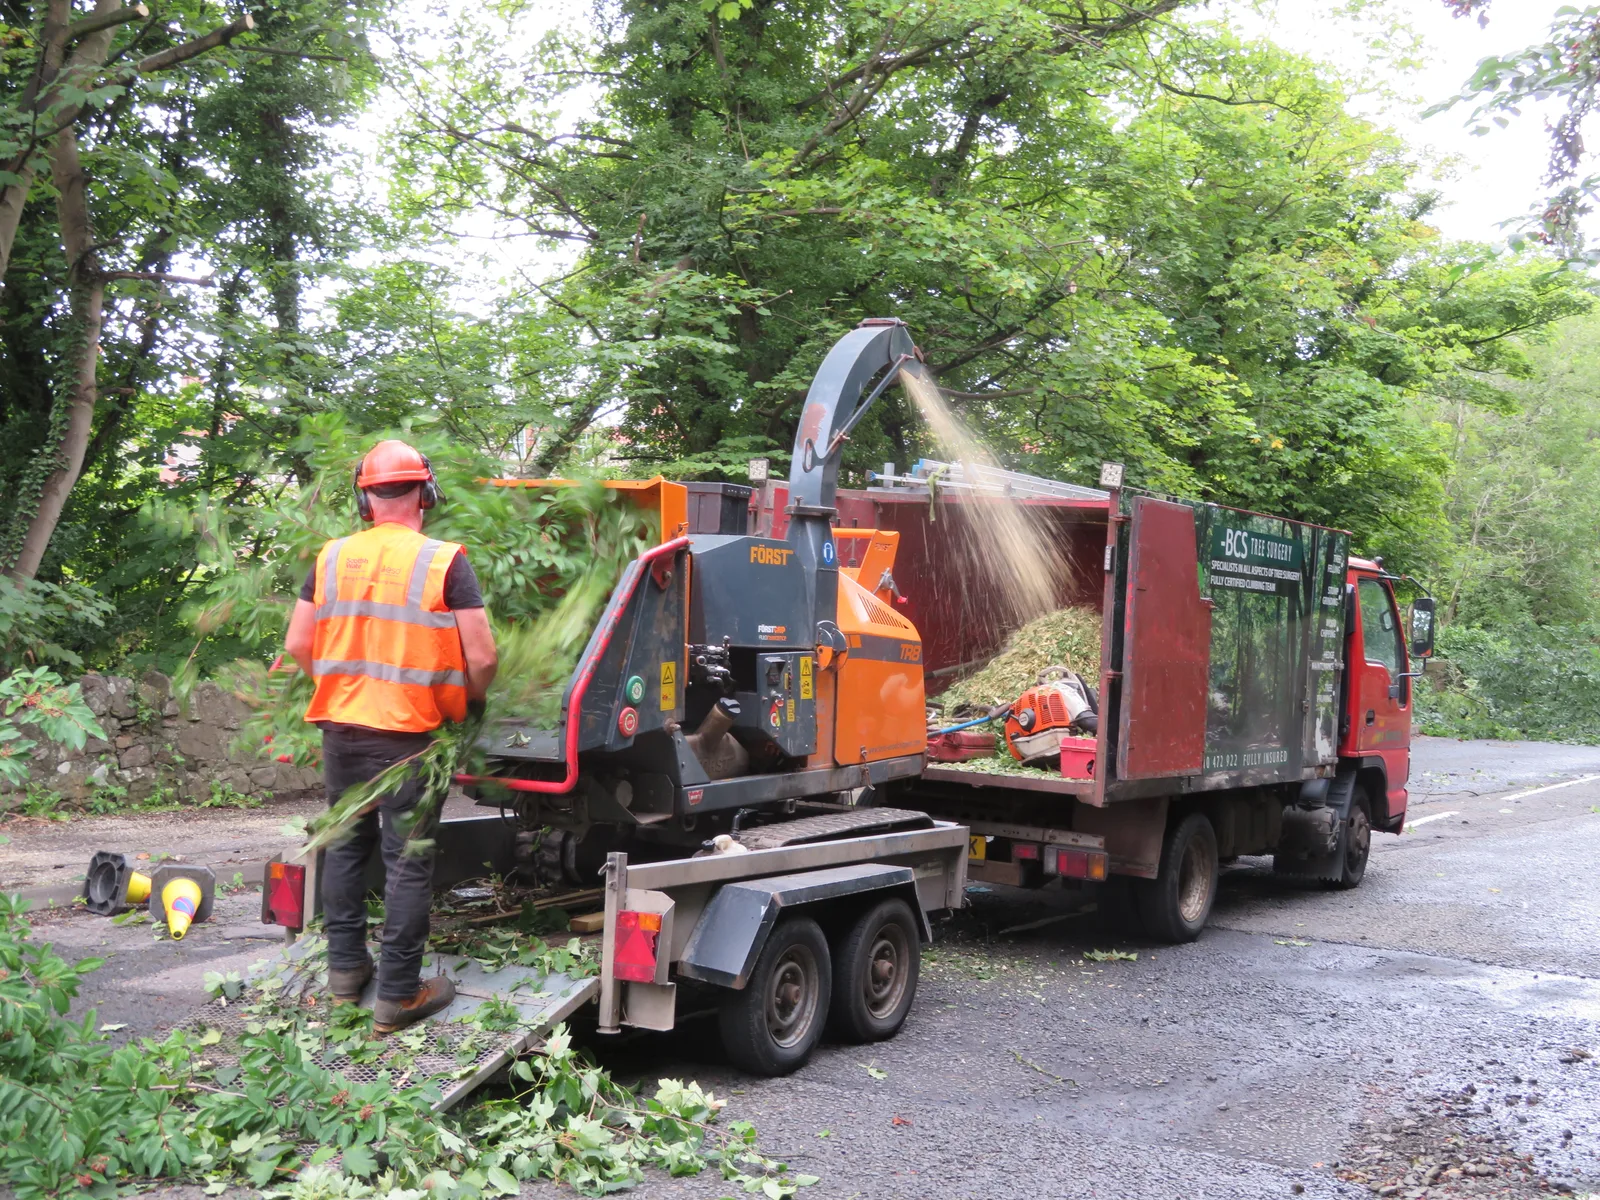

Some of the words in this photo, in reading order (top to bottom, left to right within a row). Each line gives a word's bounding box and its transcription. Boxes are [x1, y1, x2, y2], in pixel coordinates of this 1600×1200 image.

[750, 544, 793, 566] FÖRST
[1250, 538, 1265, 557] TREE
[1267, 540, 1293, 562] SURGERY
[1212, 560, 1237, 573] SPECIALISTS
[1238, 564, 1243, 573] IN
[1252, 566, 1268, 577] ASPECTS
[1268, 568, 1274, 578] OF
[1283, 570, 1300, 581] SURGERY
[1211, 575, 1224, 586] FULLY
[1224, 577, 1246, 588] CERTIFIED
[900, 644, 922, 662] TR8
[1213, 755, 1224, 768] 472
[1226, 754, 1238, 767] 922
[1243, 752, 1261, 766] FULLY
[1264, 750, 1288, 764] INSURED
